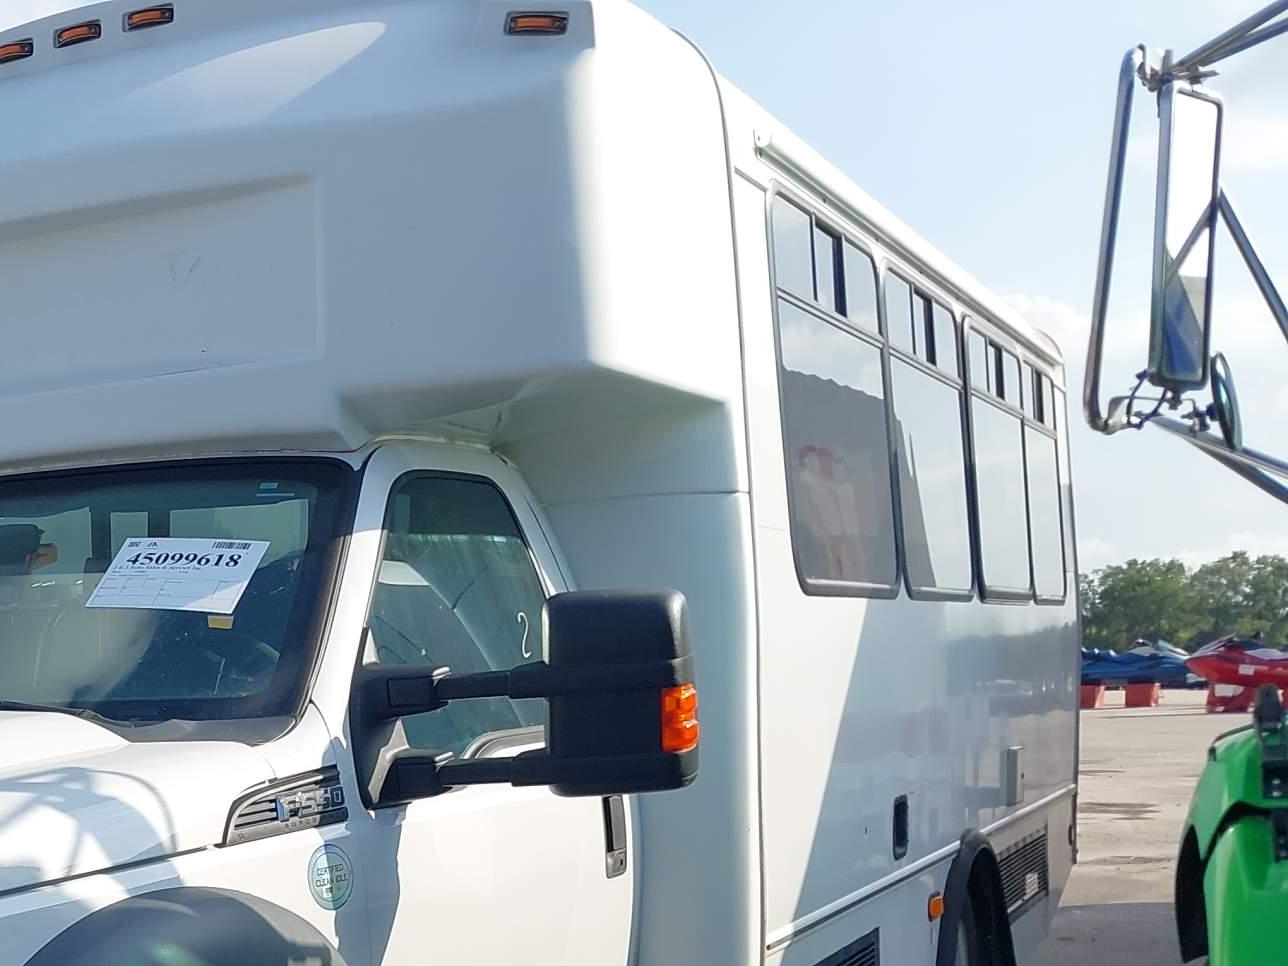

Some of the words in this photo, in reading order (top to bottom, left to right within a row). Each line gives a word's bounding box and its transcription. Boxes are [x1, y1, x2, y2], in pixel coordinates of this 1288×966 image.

[125, 551, 242, 568] 45099618
[316, 863, 344, 876] CERTIFIED
[315, 876, 334, 887] CLEAN
[335, 873, 349, 882] IDLE
